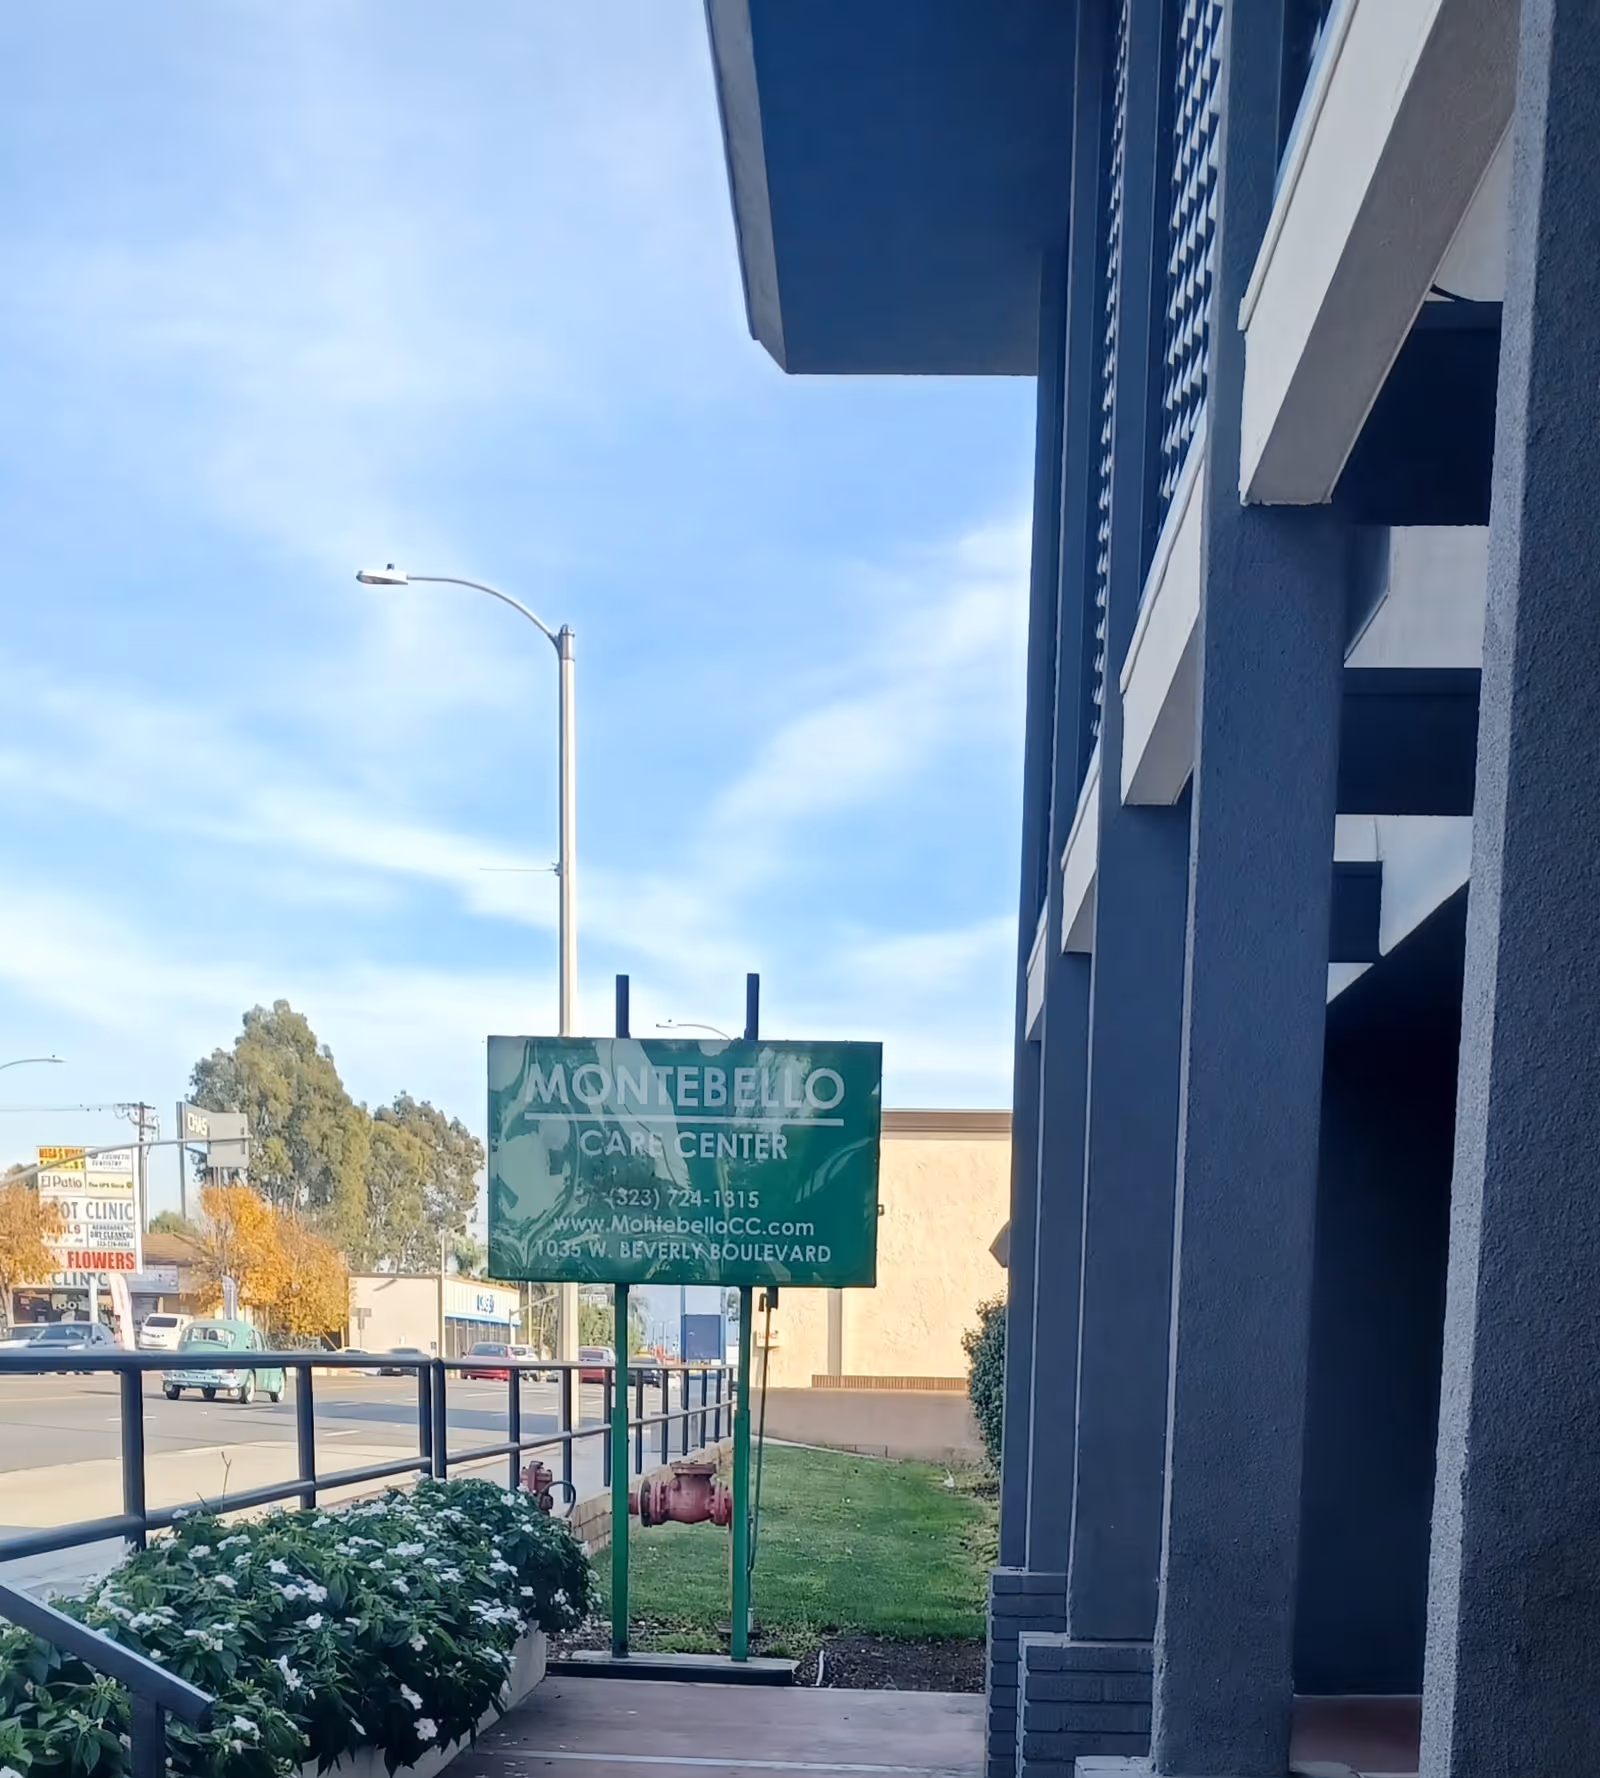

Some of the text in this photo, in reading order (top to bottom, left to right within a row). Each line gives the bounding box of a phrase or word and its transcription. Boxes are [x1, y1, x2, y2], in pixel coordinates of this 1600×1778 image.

[525, 1063, 845, 1110] MONTEBELLO
[579, 1130, 788, 1160] CARE CENTER
[41, 1175, 82, 1188] El Patio
[86, 1201, 133, 1220] CLINIC
[607, 1188, 760, 1211] (323) 724-1315
[67, 1251, 135, 1269] FLOWERS
[536, 1240, 831, 1263] 1035 W. BEVERLY BOULEVARD
